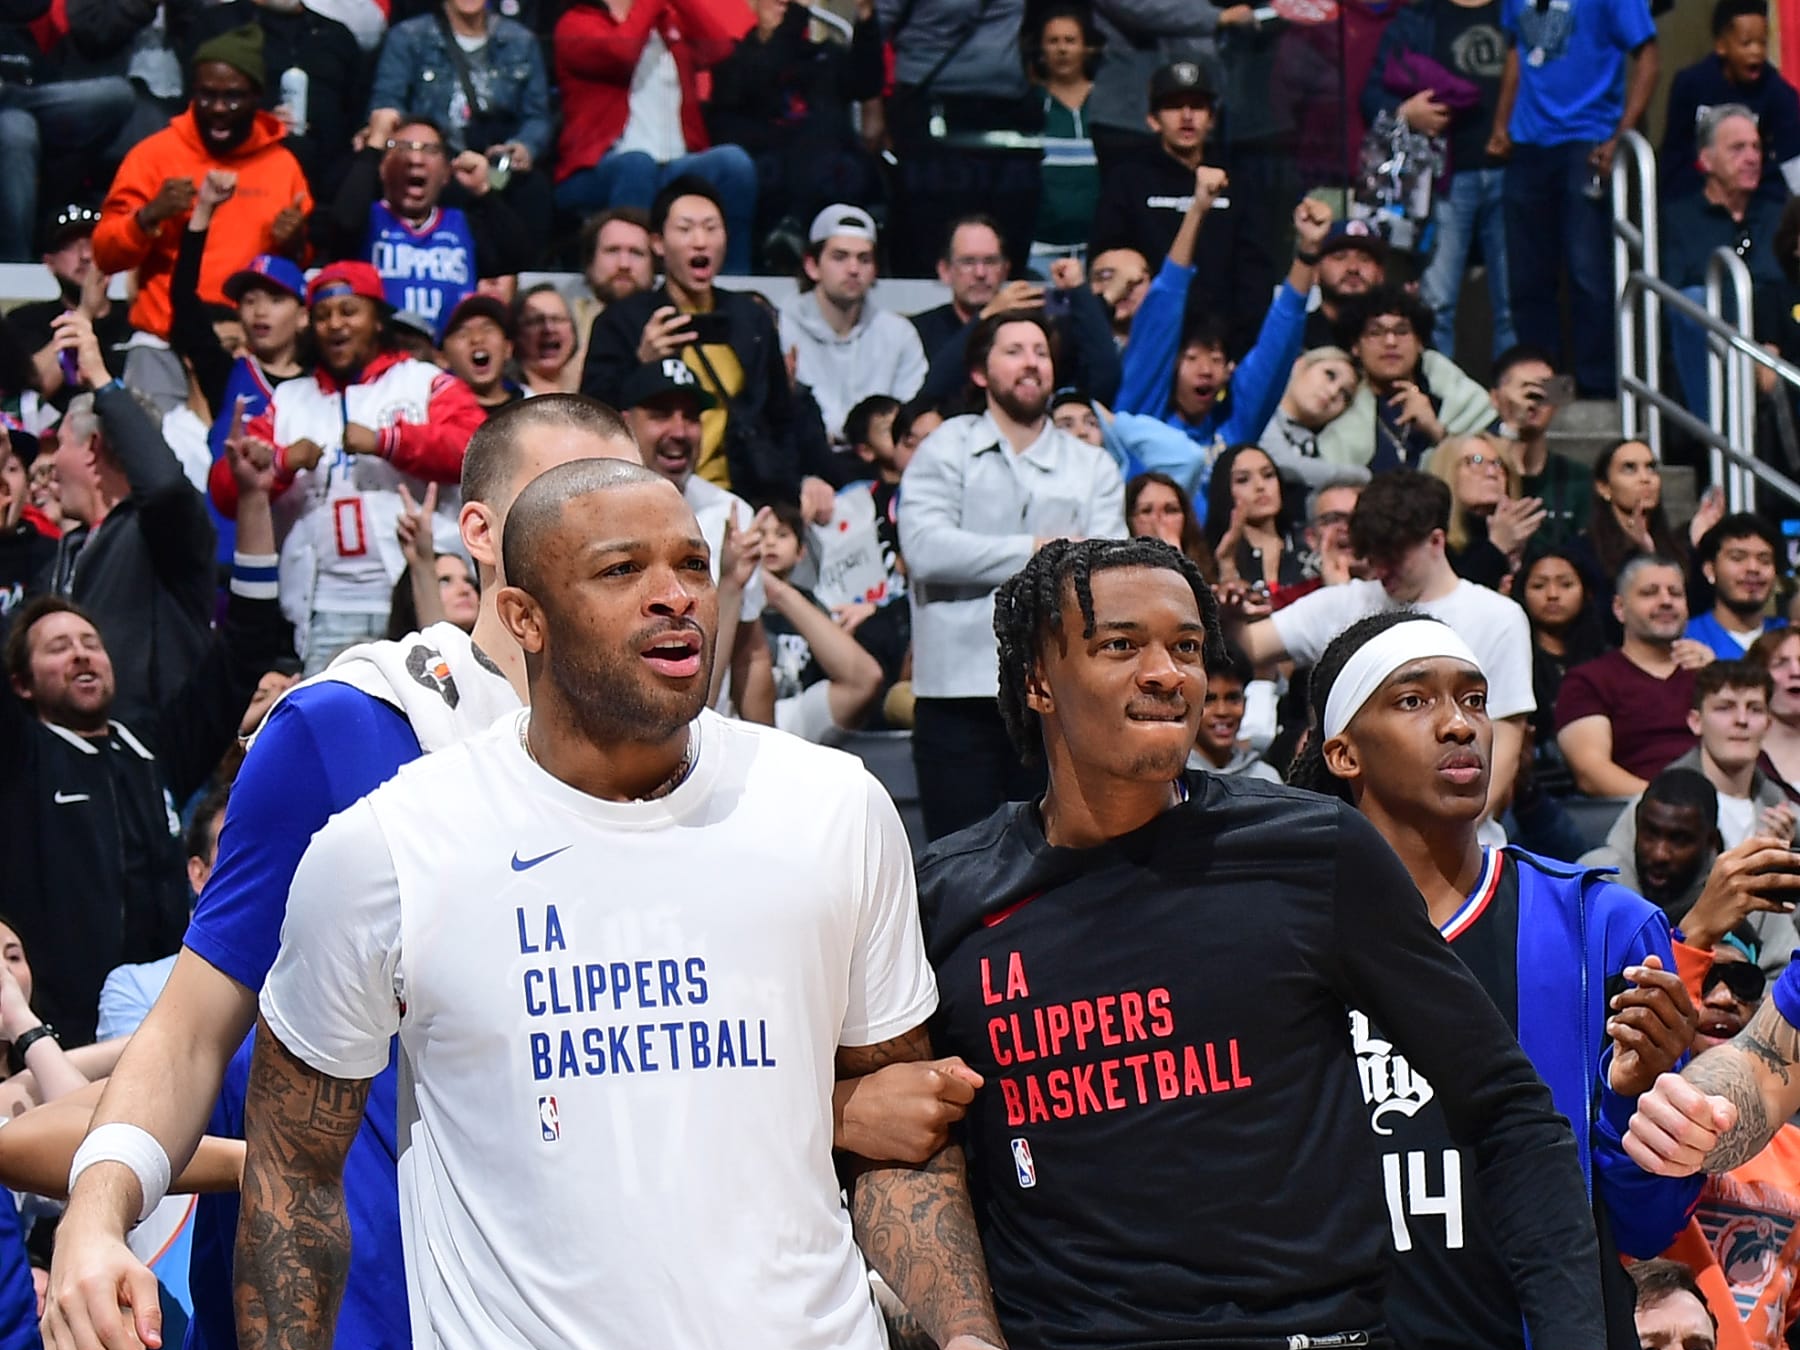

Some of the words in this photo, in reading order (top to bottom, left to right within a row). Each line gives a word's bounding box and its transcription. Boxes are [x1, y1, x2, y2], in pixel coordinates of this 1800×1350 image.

[372, 242, 468, 285] CLIPPERS
[516, 904, 567, 954] LA
[523, 957, 709, 1017] CLIPPERS
[980, 951, 1030, 1006] LA
[530, 1019, 777, 1081] BASKETBALL
[987, 987, 1176, 1067] CLIPPERS
[1000, 1038, 1253, 1127] BASKETBALL
[1382, 1149, 1465, 1252] 14
